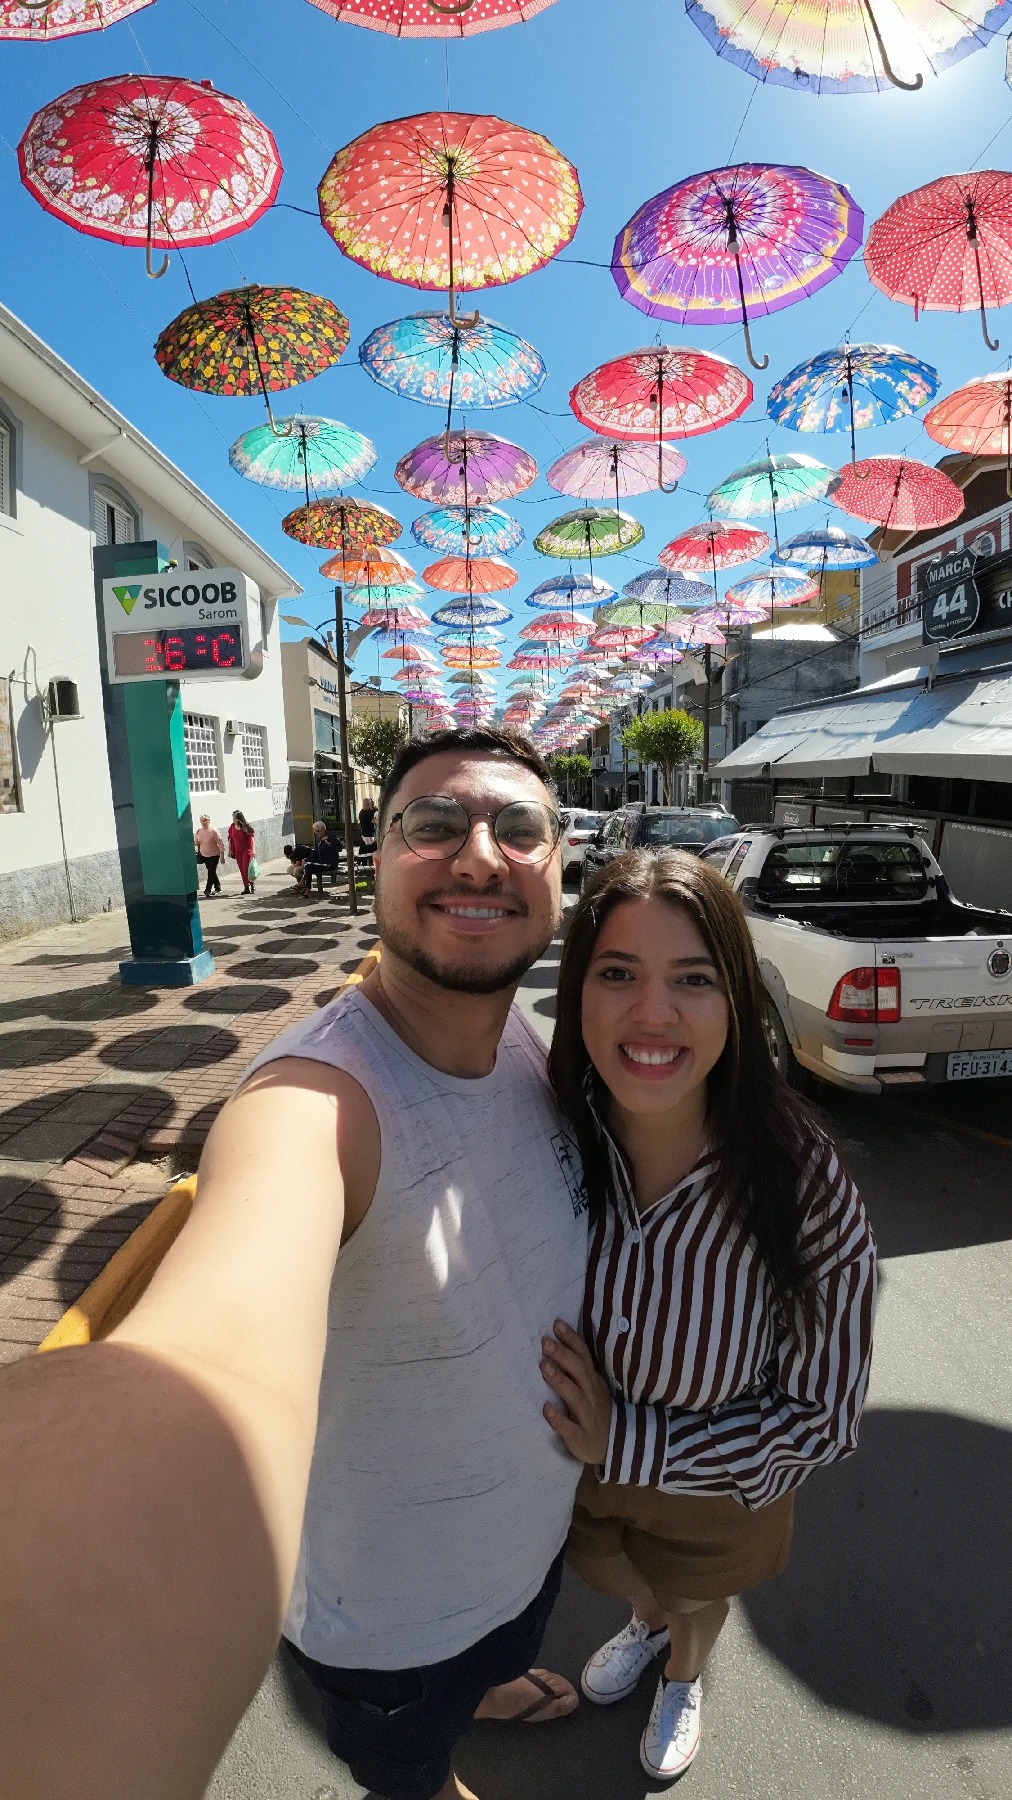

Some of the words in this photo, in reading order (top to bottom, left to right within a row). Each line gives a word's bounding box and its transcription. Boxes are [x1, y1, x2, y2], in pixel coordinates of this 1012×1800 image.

[929, 556, 971, 584] MARCA
[143, 581, 237, 609] SICOOB
[932, 583, 968, 620] 44
[198, 608, 238, 620] Sarom
